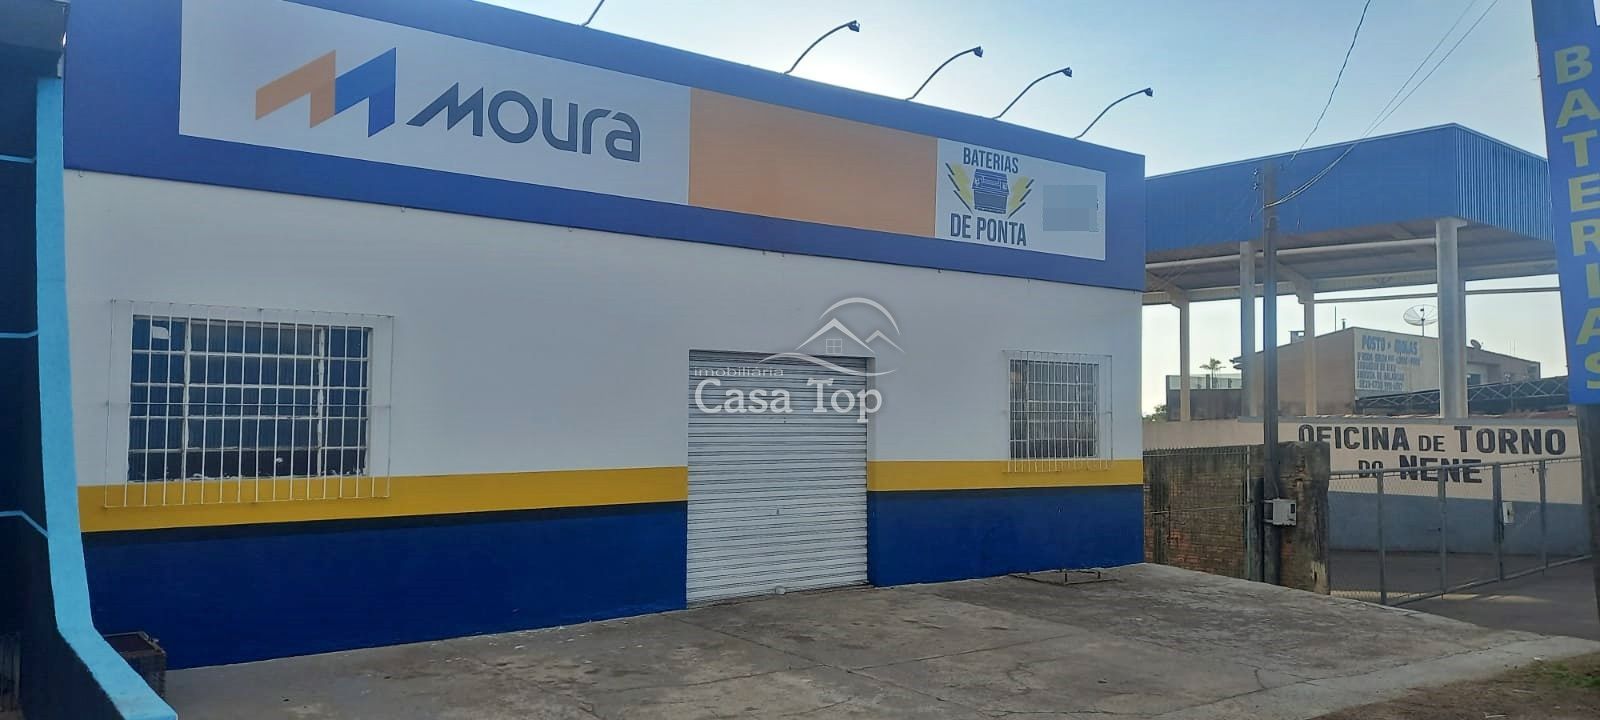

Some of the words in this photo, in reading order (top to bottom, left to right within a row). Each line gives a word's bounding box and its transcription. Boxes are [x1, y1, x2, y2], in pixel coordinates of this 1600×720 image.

[963, 146, 1019, 174] BATERIAS
[950, 213, 972, 239] DE
[976, 217, 1027, 246] PONTA
[1361, 335, 1386, 352] POSTO
[1298, 424, 1410, 452] OFICINA
[1418, 435, 1446, 453] DE
[1454, 425, 1567, 456] TORNO
[1399, 455, 1482, 484] NENE
